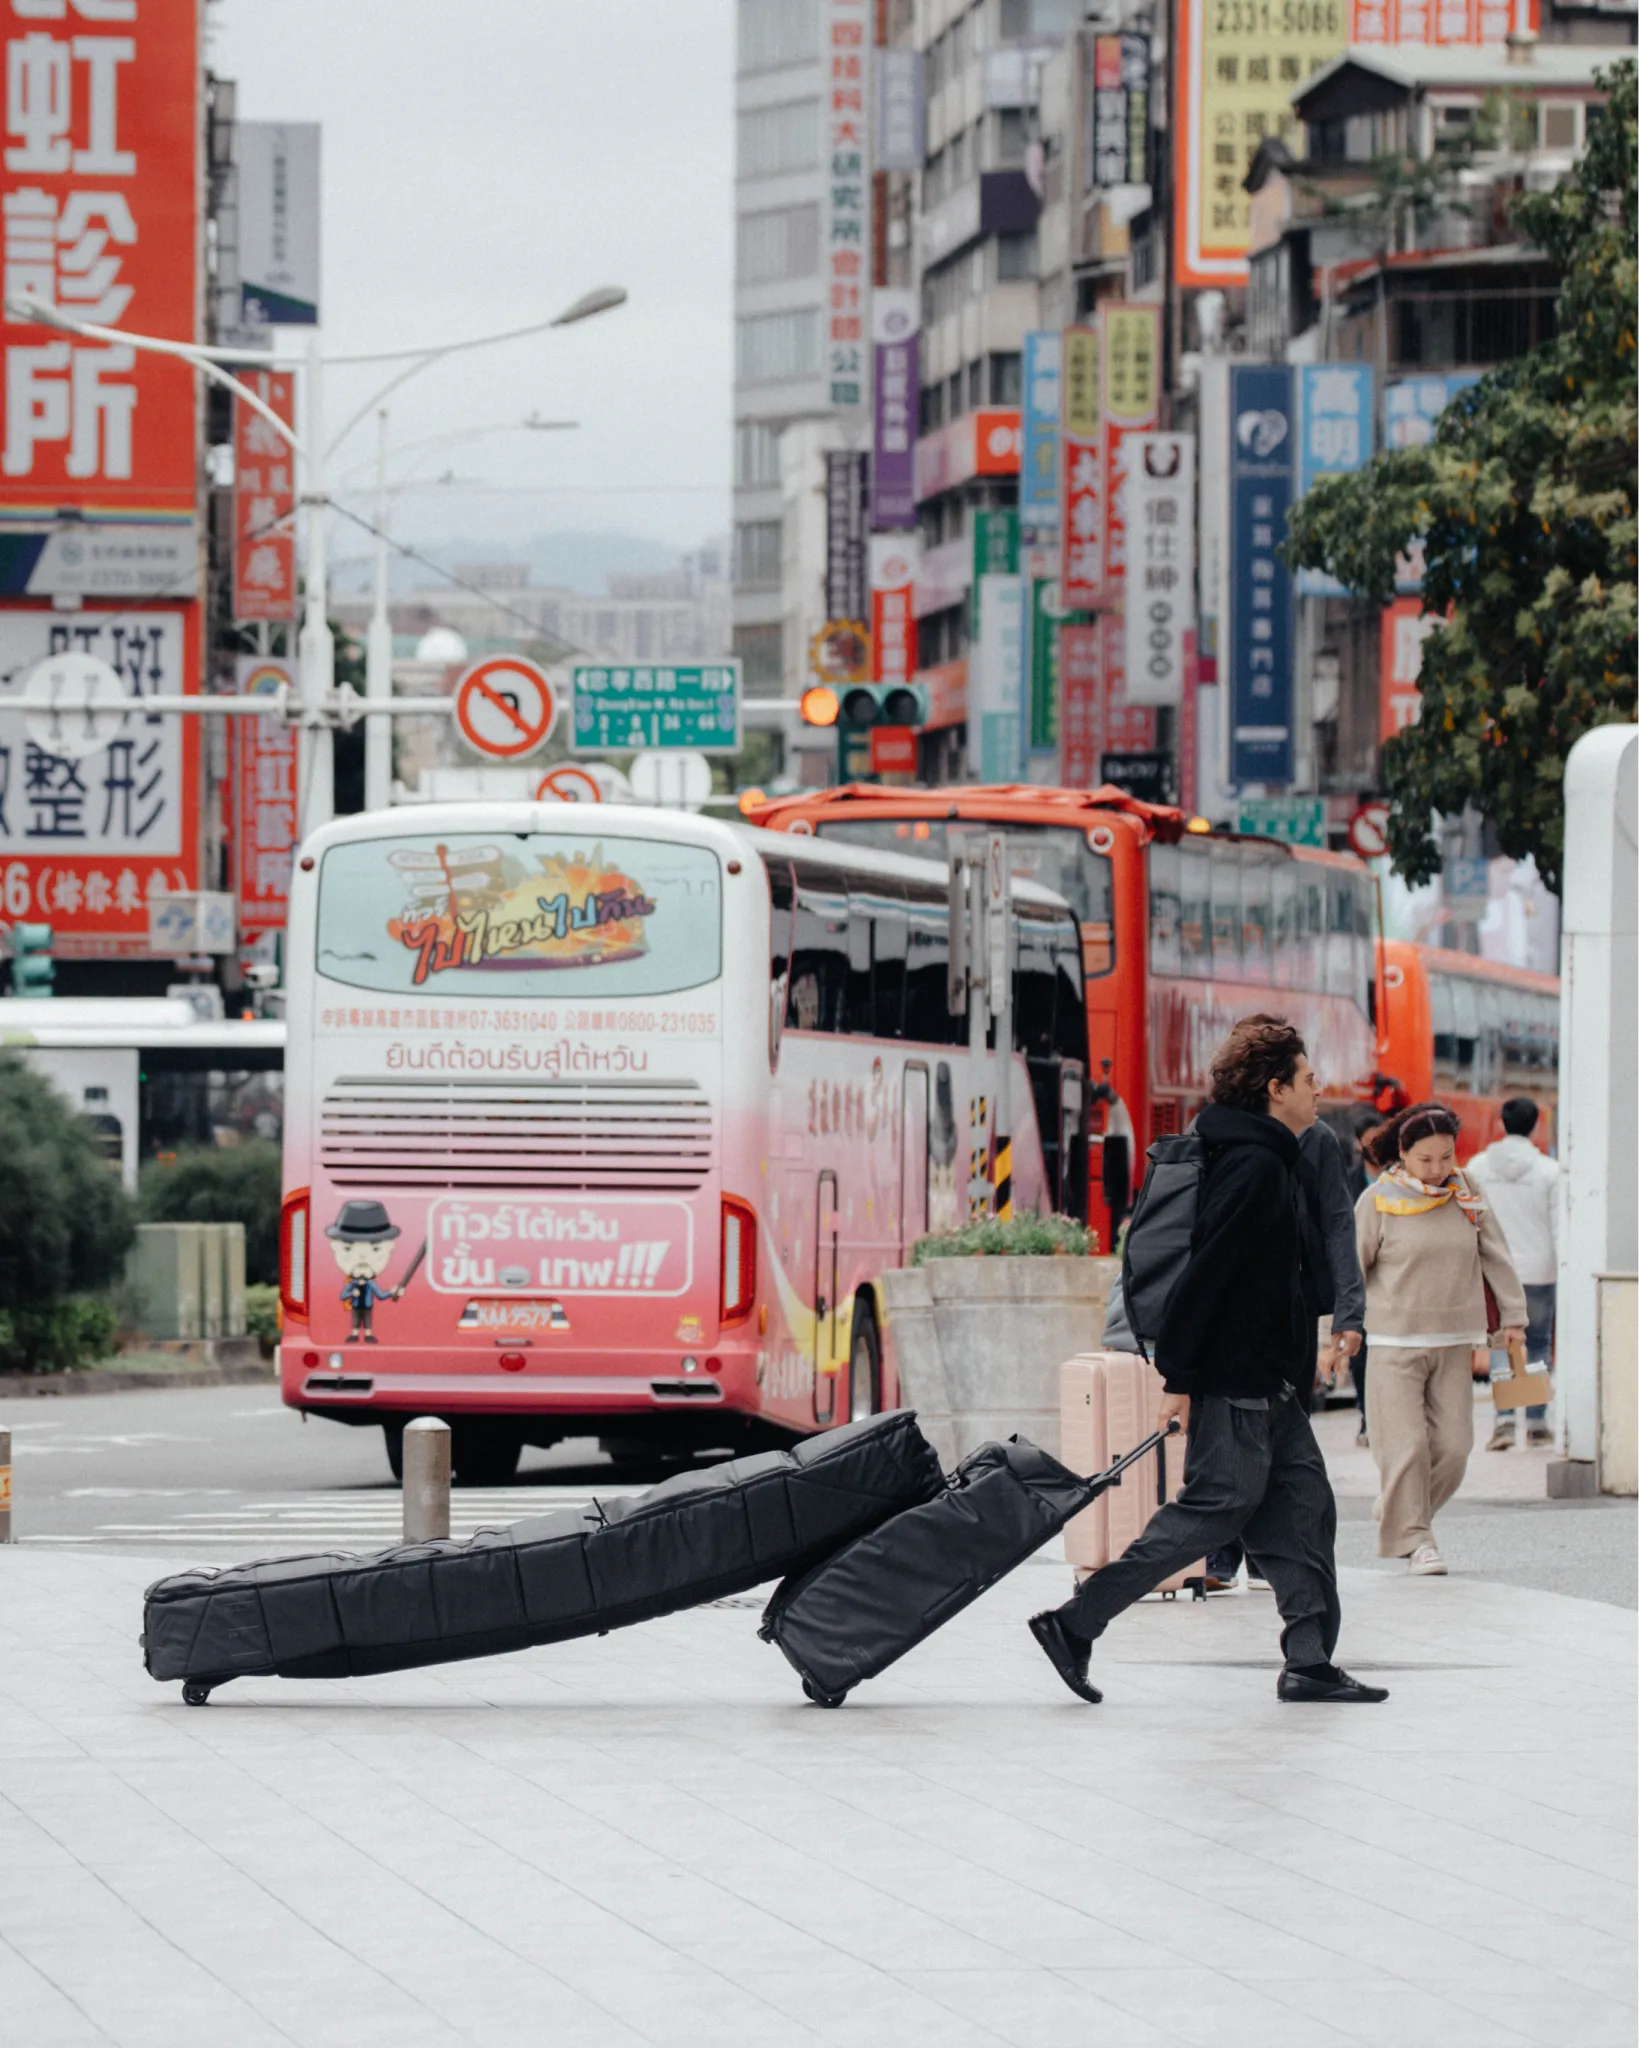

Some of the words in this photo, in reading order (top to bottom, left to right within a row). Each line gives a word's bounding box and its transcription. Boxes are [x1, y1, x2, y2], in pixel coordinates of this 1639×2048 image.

[0, 0, 139, 480] 虹診所
[0, 740, 165, 838] 整形
